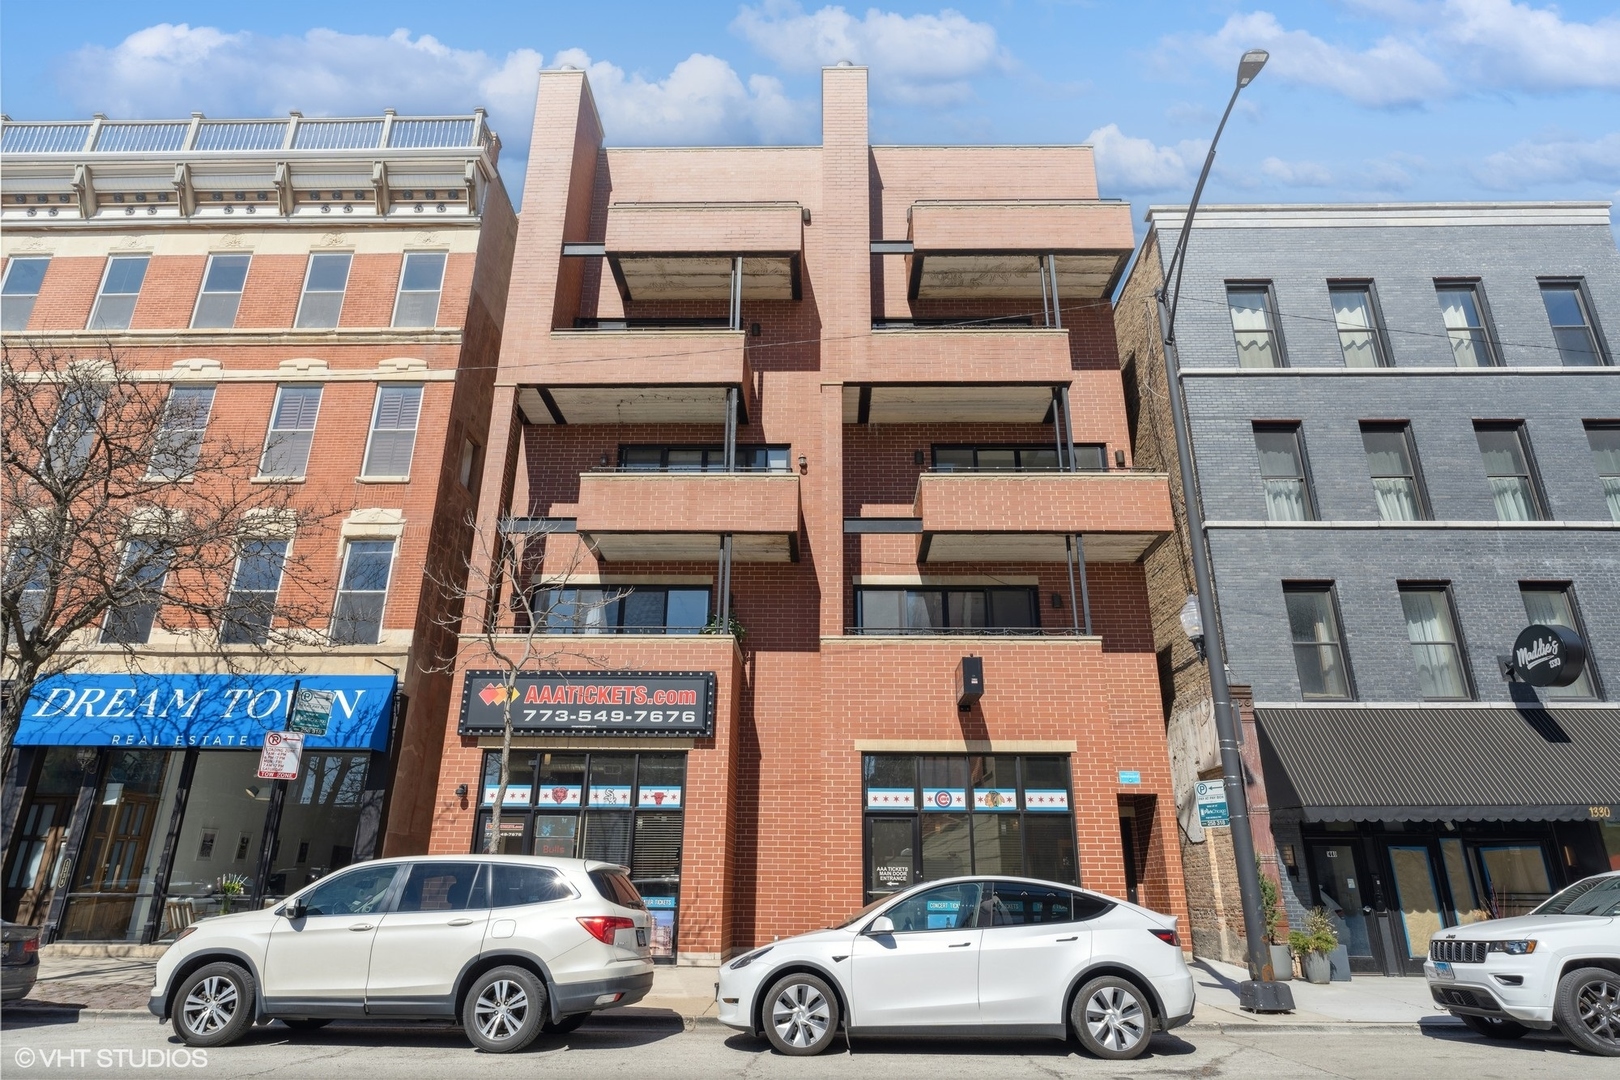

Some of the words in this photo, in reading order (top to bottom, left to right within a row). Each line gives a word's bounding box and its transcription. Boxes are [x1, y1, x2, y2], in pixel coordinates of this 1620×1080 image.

[1516, 636, 1558, 667] Maddie's
[31, 688, 208, 719] DREAM
[219, 687, 367, 719] TON
[524, 685, 697, 705] AAATICKETS.com
[523, 710, 696, 723] 773-549-7676
[111, 735, 161, 746] REAL
[175, 735, 249, 746] ESTATE
[1589, 806, 1610, 818] 1330
